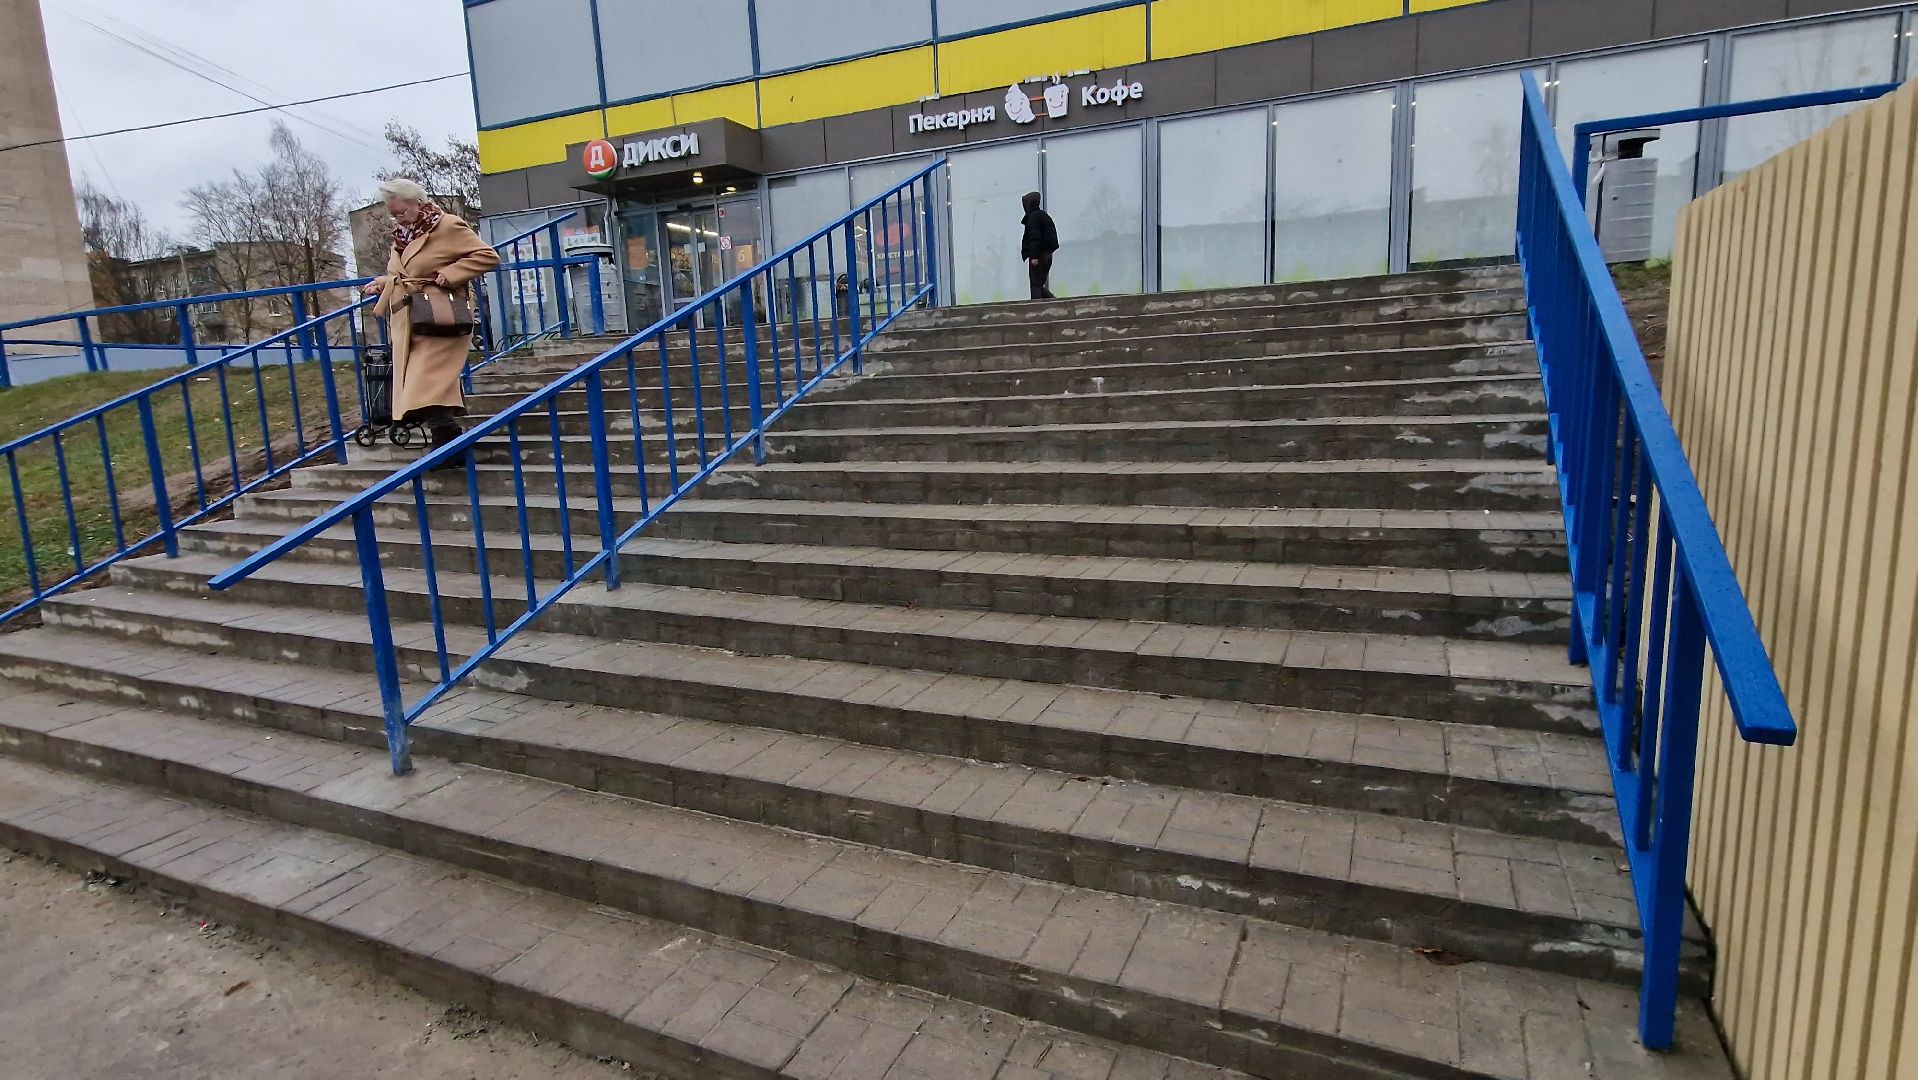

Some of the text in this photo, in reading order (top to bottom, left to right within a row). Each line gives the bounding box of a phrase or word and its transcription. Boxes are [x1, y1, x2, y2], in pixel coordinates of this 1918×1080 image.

[908, 78, 1144, 134] Пекарня Кофе
[589, 132, 700, 168] Д ДИКСИ
